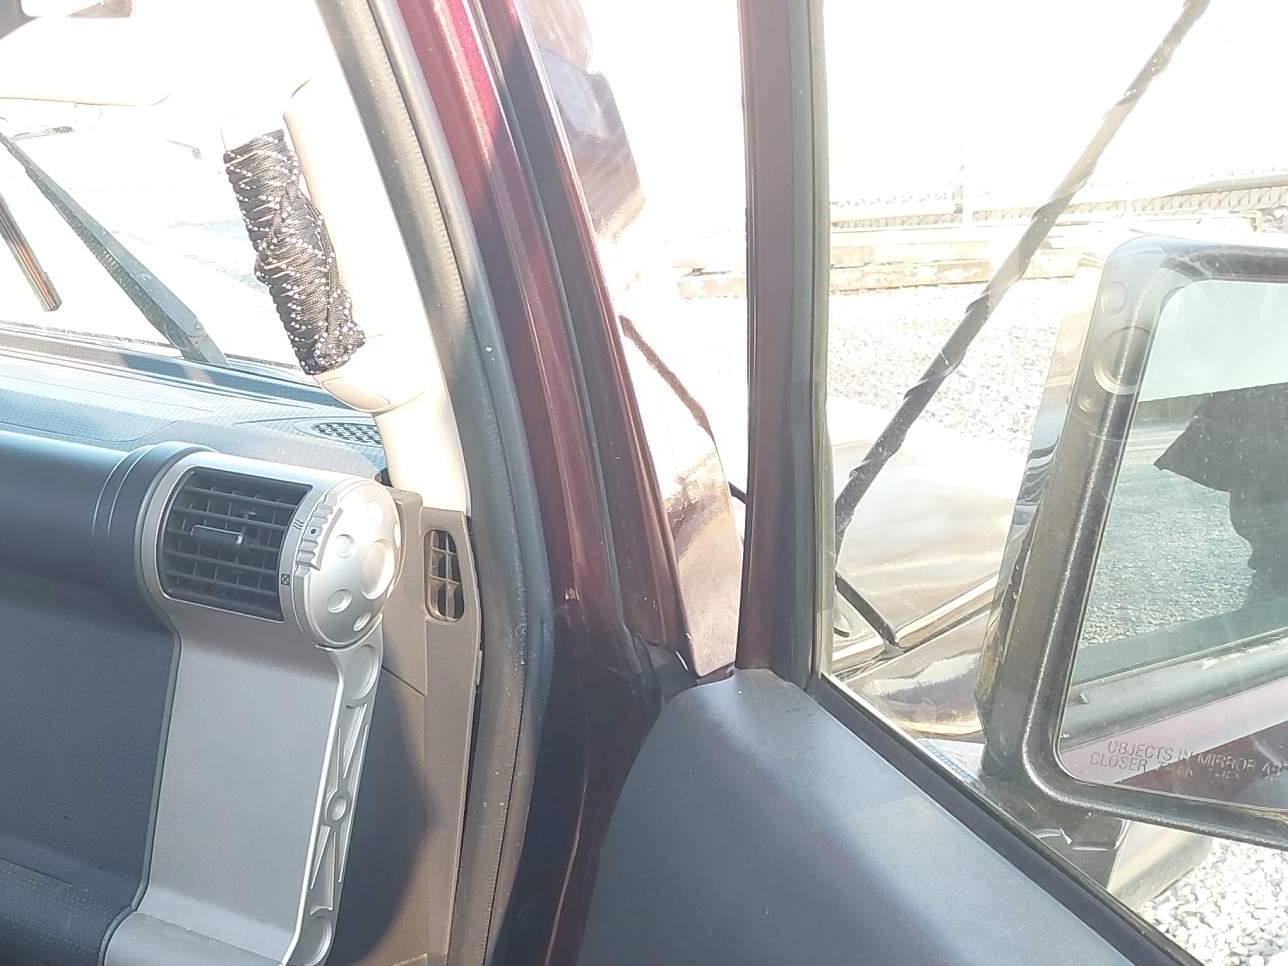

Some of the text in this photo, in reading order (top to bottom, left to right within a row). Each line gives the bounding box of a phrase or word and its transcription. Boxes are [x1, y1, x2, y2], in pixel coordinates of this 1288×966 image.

[1089, 751, 1148, 772] CLOSER
[1107, 739, 1173, 762] OBJECTS
[1197, 753, 1256, 772] MIRROR
